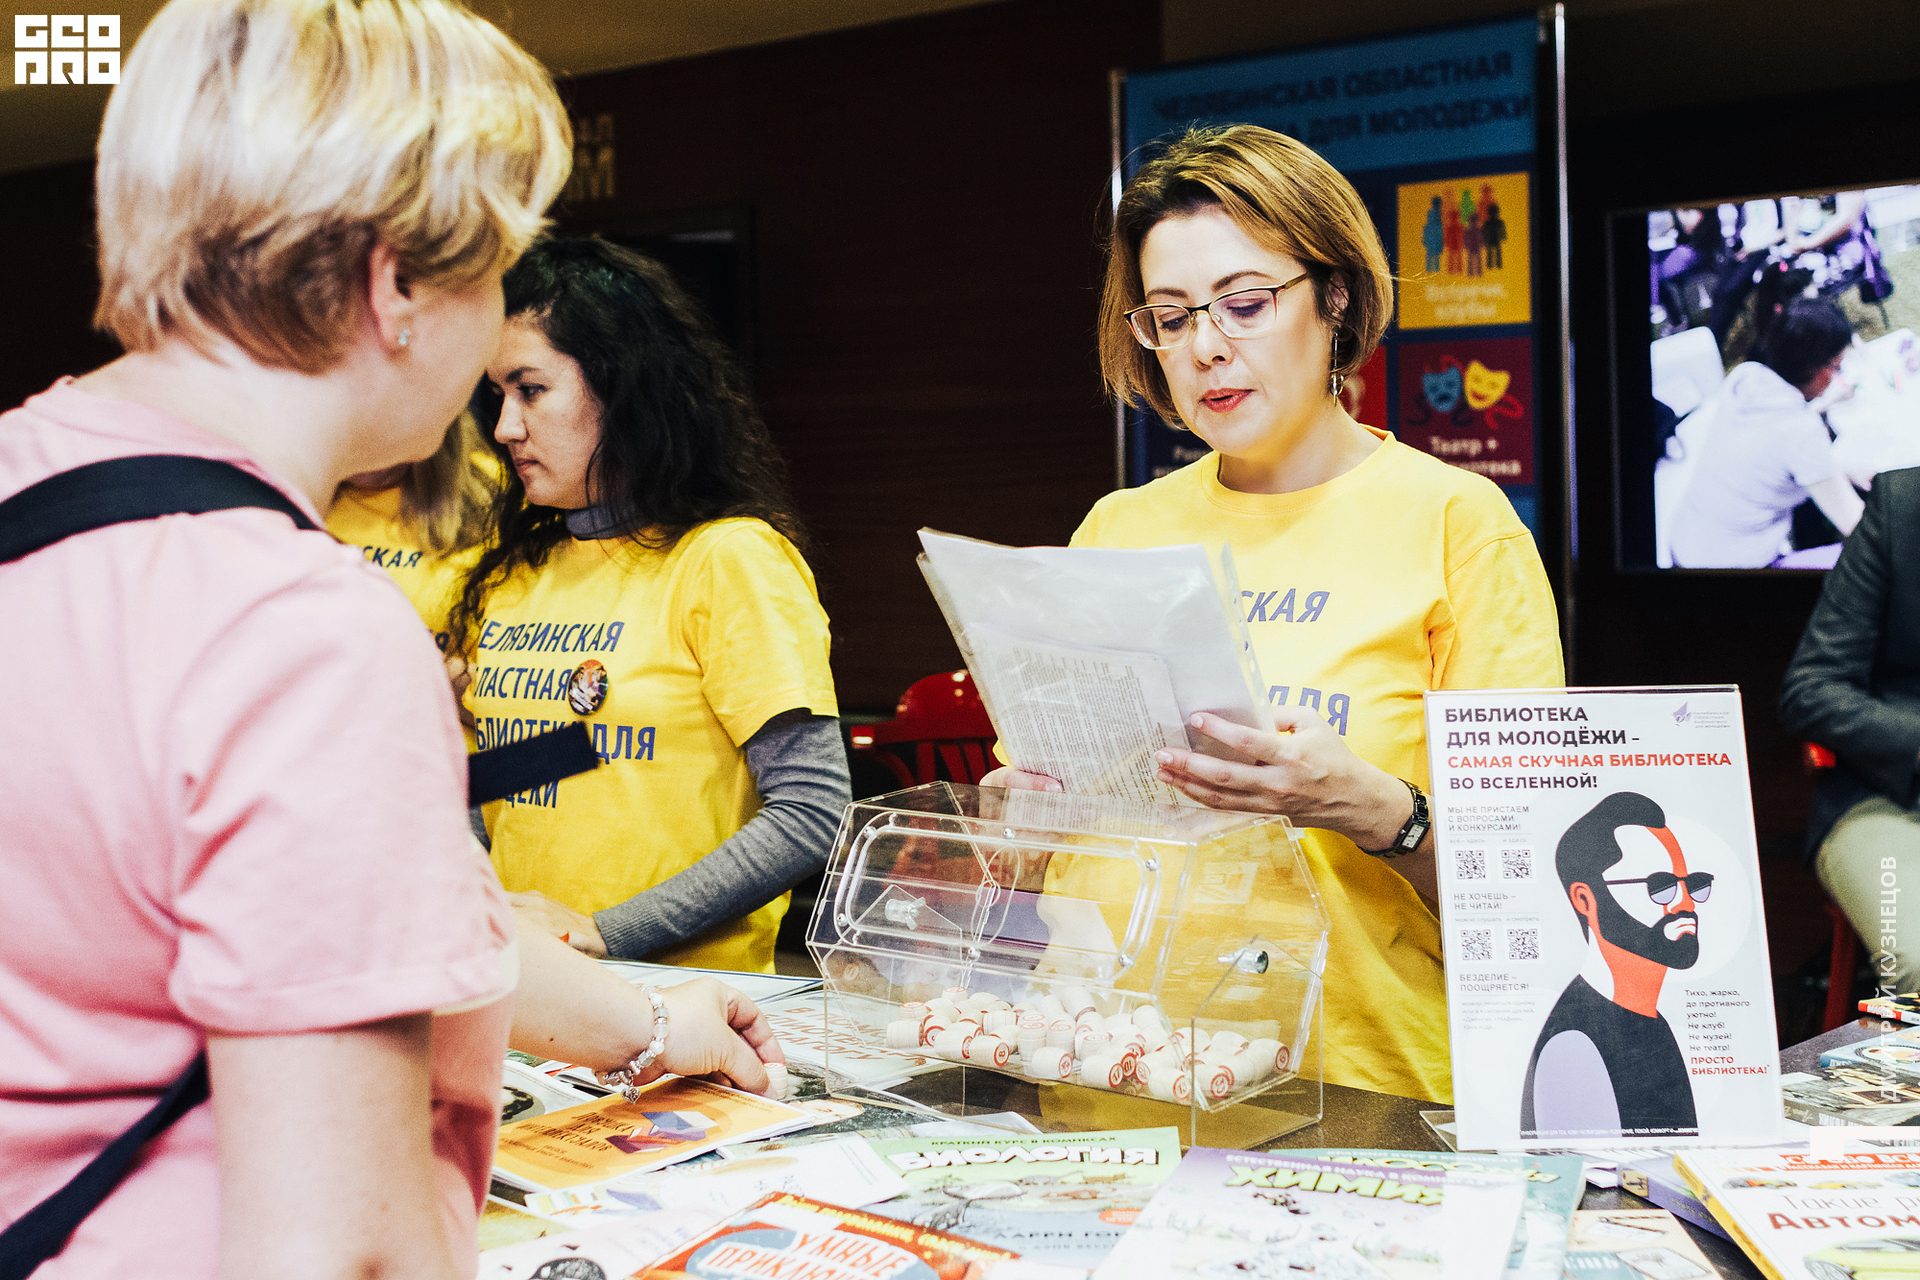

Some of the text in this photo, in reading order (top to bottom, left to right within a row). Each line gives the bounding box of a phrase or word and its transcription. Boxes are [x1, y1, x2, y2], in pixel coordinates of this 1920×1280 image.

[478, 618, 625, 653] ЕЛЯБИНСКАЯ
[474, 666, 573, 702] ЛАСТНАЯ
[1445, 706, 1589, 723] БИБЛИОТЕКА
[1446, 731, 1491, 749] ДЛЯ
[1498, 726, 1627, 748] МОЛОДЁЖИ
[592, 723, 656, 765] ДЛЯ
[1448, 753, 1732, 769] САМАЯ СКУЧНАЯ БИБЛИОТЕКА
[1450, 771, 1598, 790] ВО ВСЕЛЕННОЙ!
[1447, 806, 1463, 814] МЫ
[1480, 805, 1530, 813] ПРИСТАЕМ
[1448, 815, 1515, 823] С ВОПРОСАМИ
[1448, 823, 1521, 832] И КОНКУРСАМИ!
[1453, 892, 1466, 901] НЕ
[1469, 892, 1509, 901] ХОЧЕШЬ
[1454, 901, 1503, 910] НЕ ЧИТАЙ!
[1459, 973, 1510, 982] БЕЗДЕЛИЕ
[1460, 983, 1530, 992] ПООЩРЯЕТСЯ!
[1686, 1011, 1716, 1019] уютно!
[1701, 1021, 1725, 1030] клуб!
[1702, 1032, 1732, 1041] музей!
[1703, 1044, 1730, 1052] театр!
[1690, 1056, 1734, 1064] ПРОСТО
[1691, 1066, 1768, 1075] БИБЛИОТЕКА!
[1042, 1136, 1117, 1144] КОМИКСАХ
[886, 1144, 1160, 1173] БИОЛОГИЯ
[795, 1232, 910, 1278] УМНЫЕ
